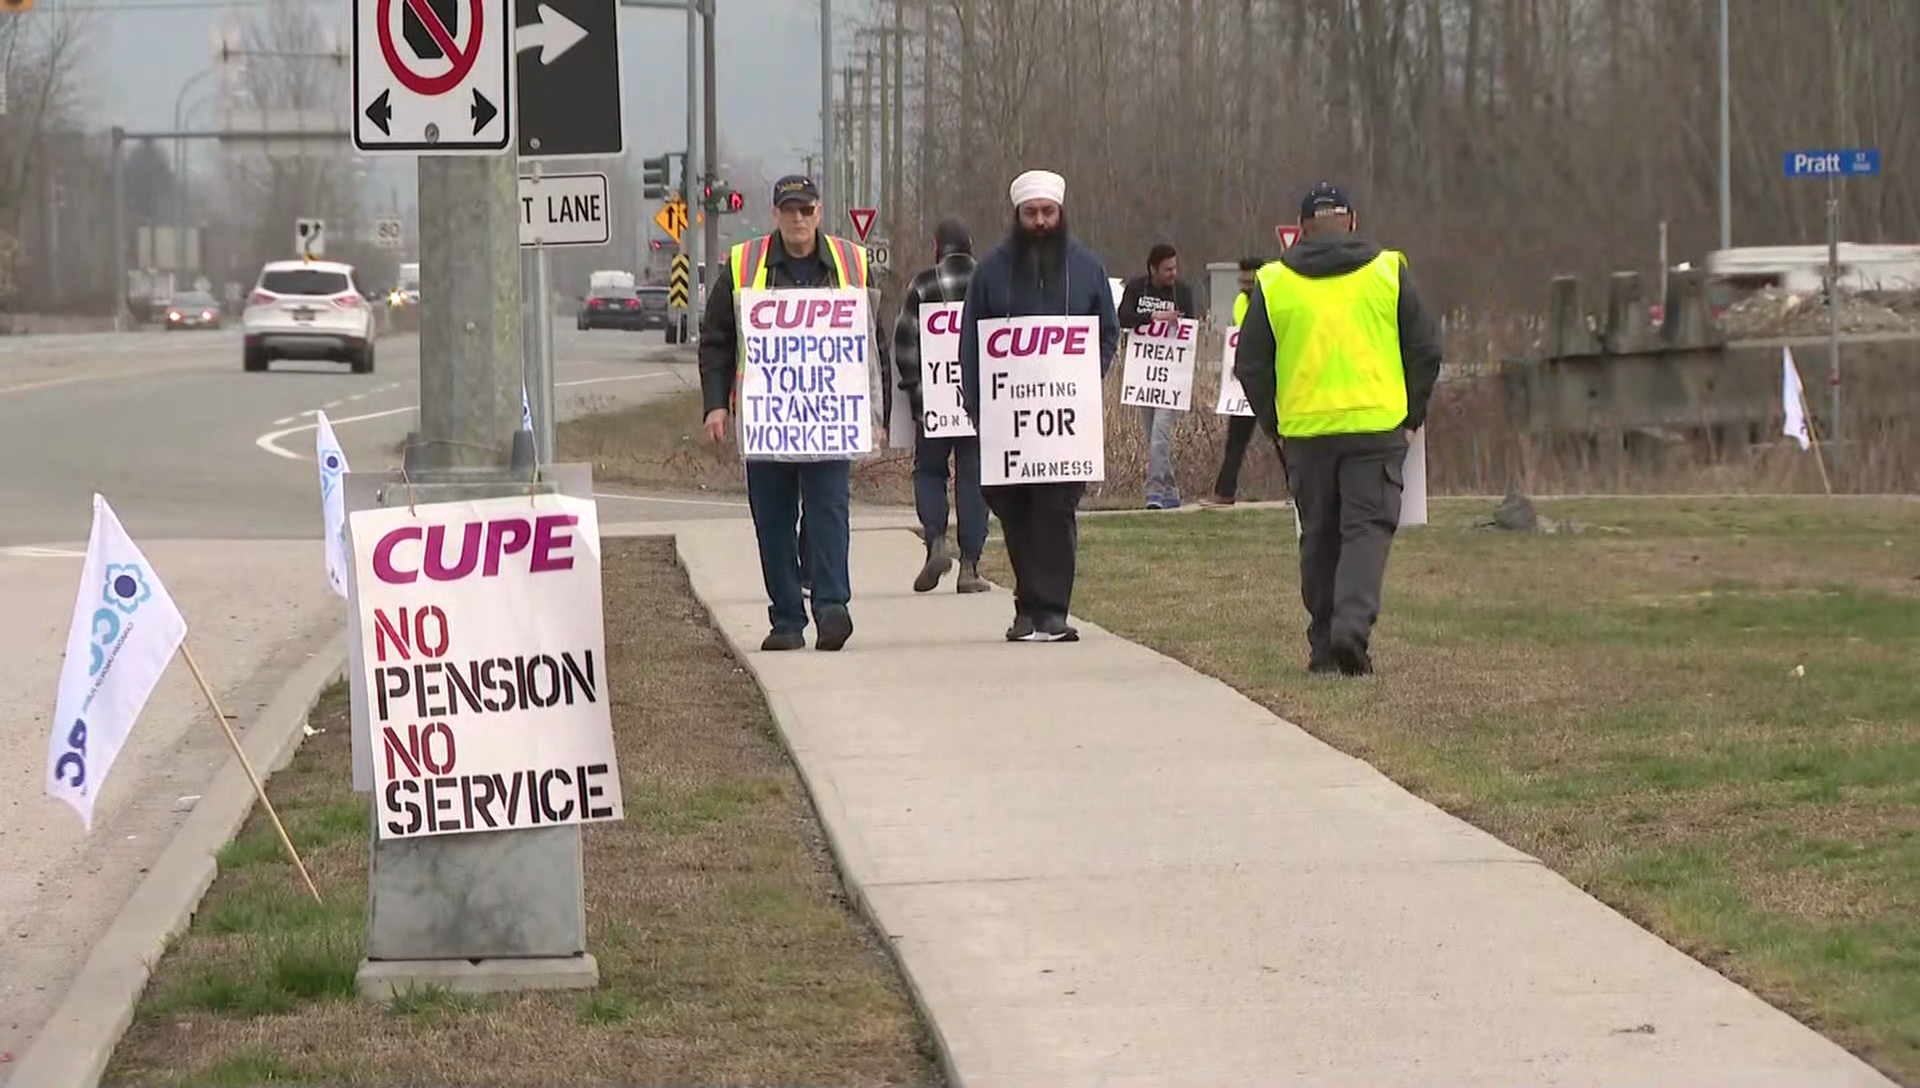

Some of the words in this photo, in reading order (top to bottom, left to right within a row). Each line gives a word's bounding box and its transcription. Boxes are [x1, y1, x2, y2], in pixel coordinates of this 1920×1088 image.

[1794, 153, 1840, 173] Pratt
[548, 195, 601, 223] LANE
[378, 222, 400, 238] 80
[749, 299, 857, 329] CUPE
[747, 335, 866, 364] SUPPORT
[986, 326, 1090, 358] CUPE
[1133, 342, 1186, 363] TREAT
[762, 365, 836, 394] YOUR
[1146, 366, 1169, 382] US
[747, 395, 864, 423] TRANSIT
[1124, 386, 1181, 406] FAIRLY
[1014, 408, 1076, 437] FOR
[746, 424, 860, 452] WORKER
[372, 514, 579, 585] CUPE
[374, 604, 449, 662] NO
[375, 649, 597, 721] PENSION
[383, 722, 456, 780] NO
[385, 763, 613, 835] SERVICE
